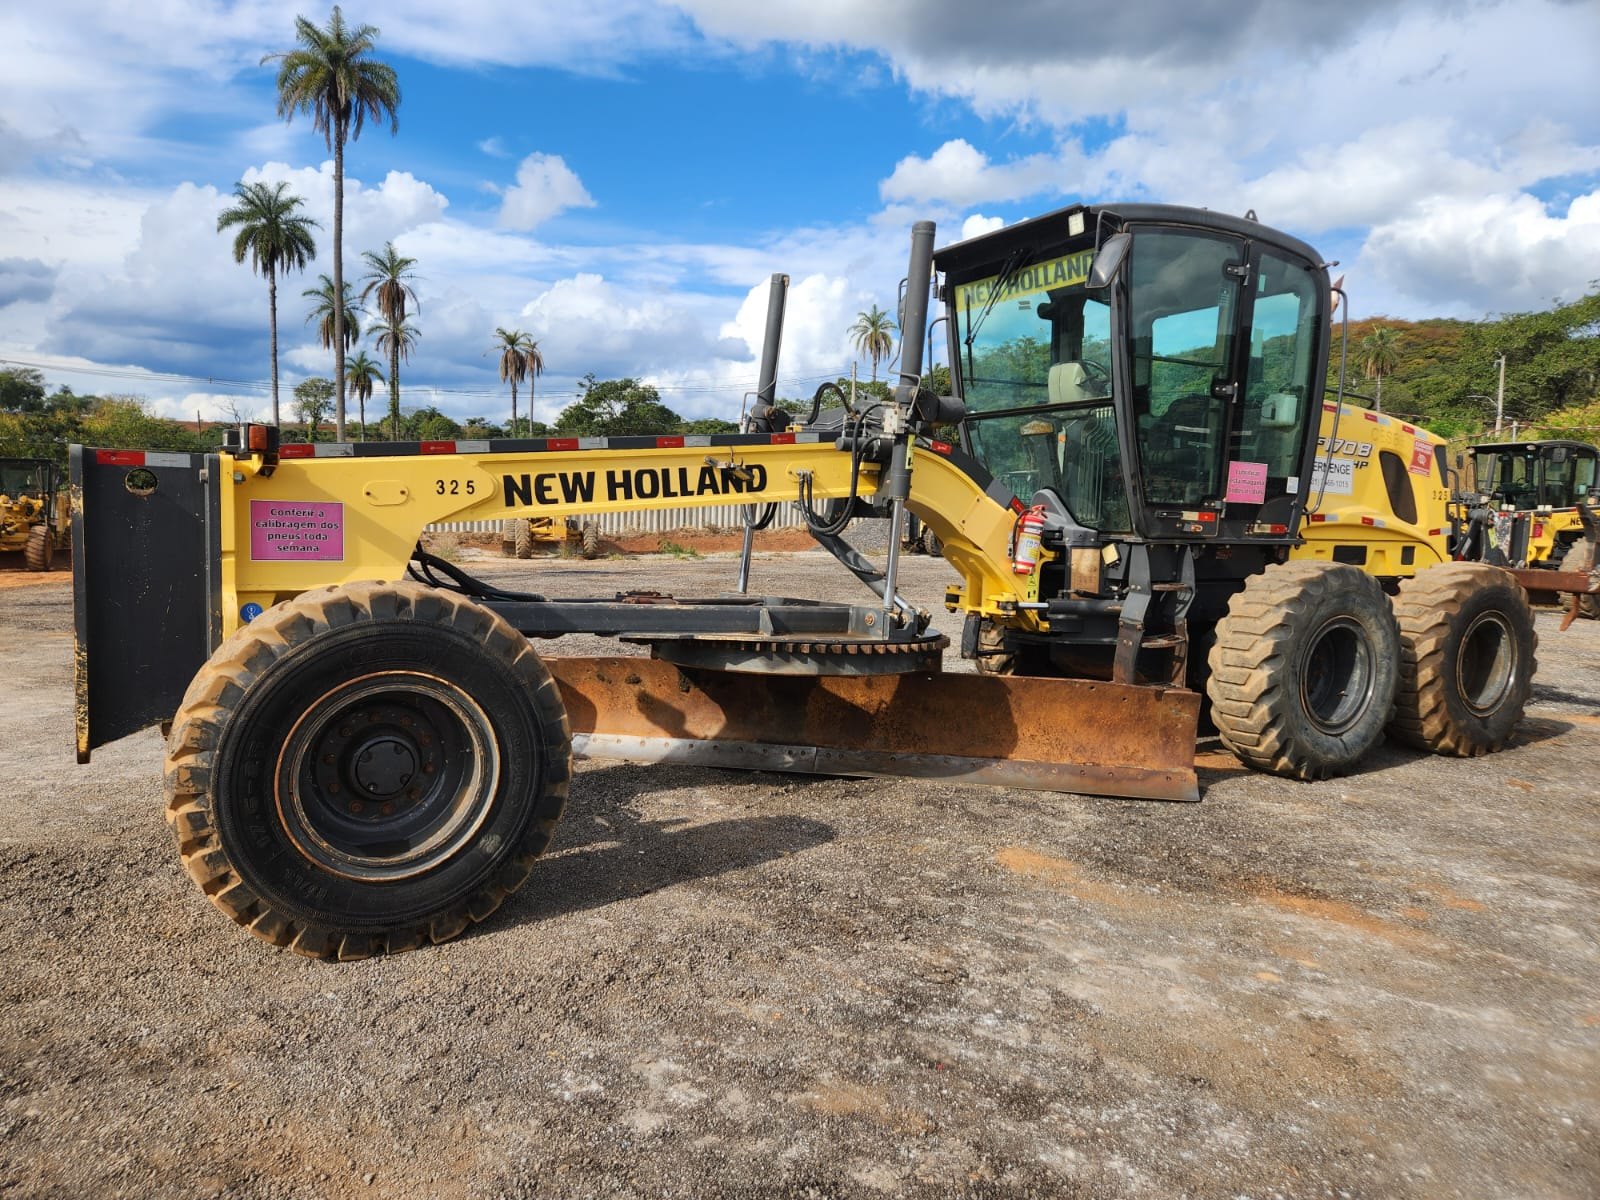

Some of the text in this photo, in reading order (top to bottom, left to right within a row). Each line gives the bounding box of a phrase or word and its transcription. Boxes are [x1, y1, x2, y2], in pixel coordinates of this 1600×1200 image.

[962, 253, 1094, 305] NEW HOLLAND
[436, 479, 475, 495] 325
[503, 464, 768, 507] NEW HOLLAND
[270, 508, 325, 518] Conferir a
[255, 519, 340, 530] calibragem dos
[1569, 517, 1582, 527] NE
[267, 532, 328, 541] pneus toda
[276, 544, 320, 552] semana
